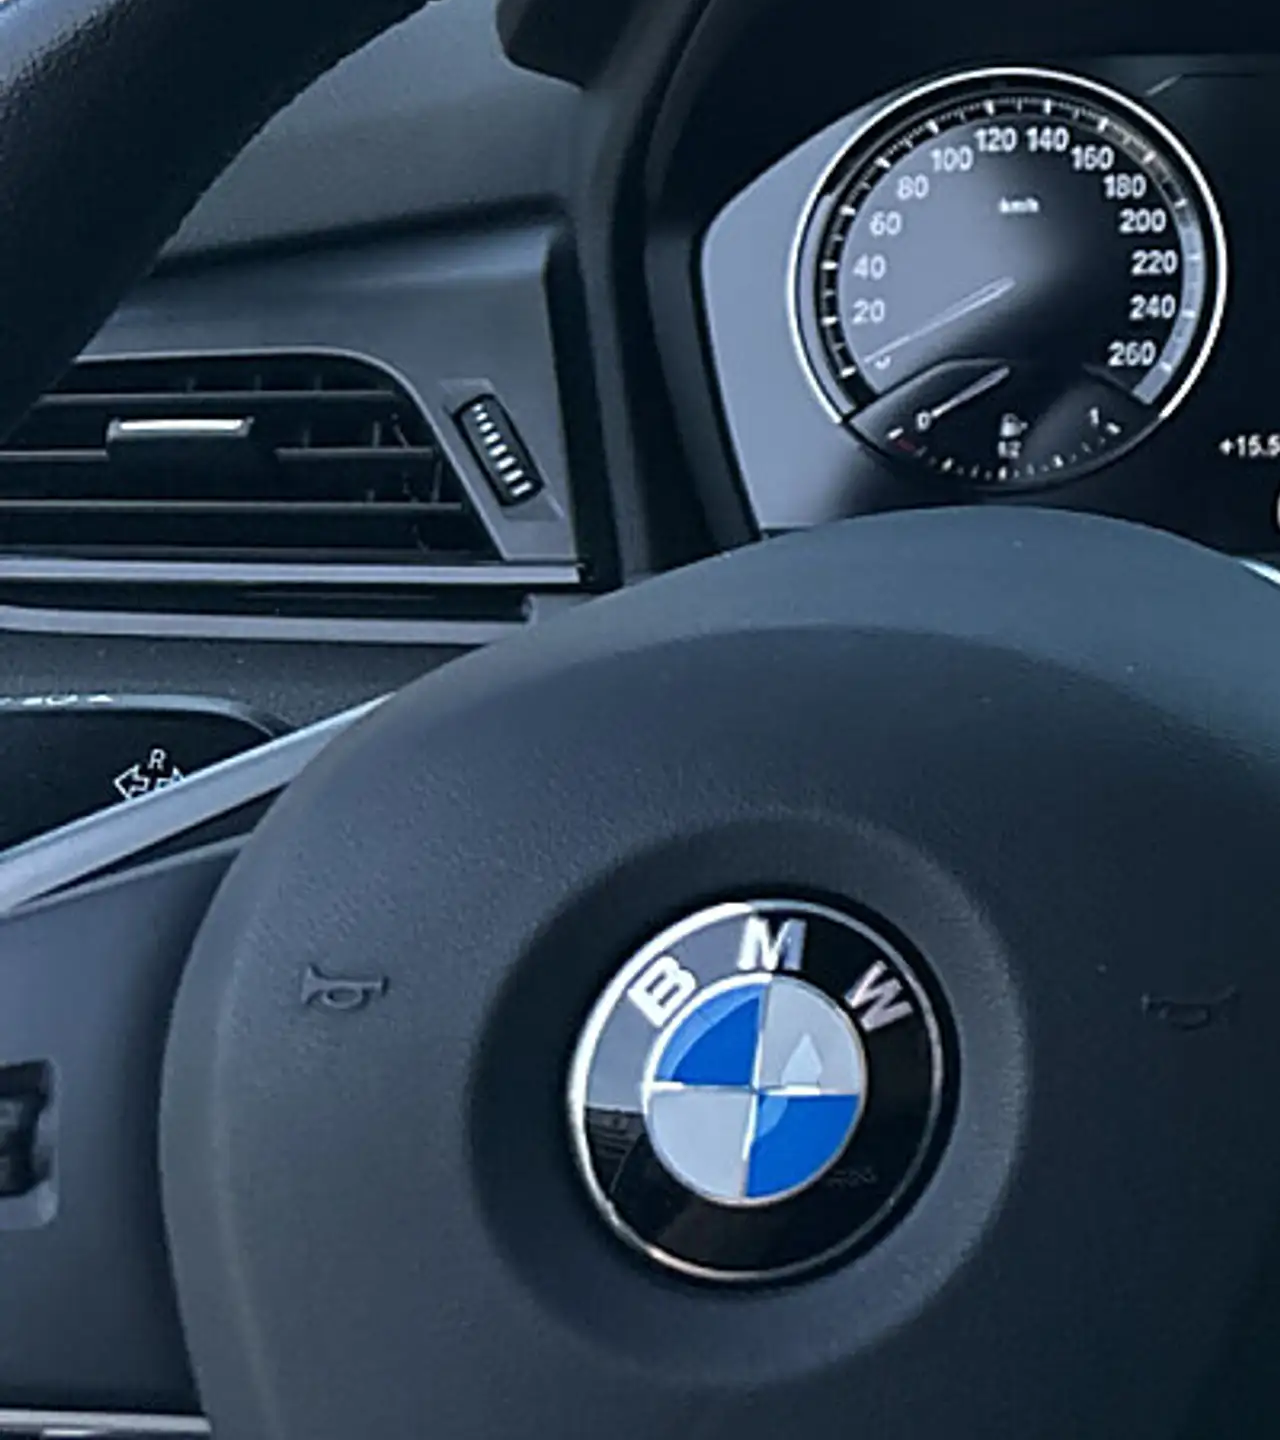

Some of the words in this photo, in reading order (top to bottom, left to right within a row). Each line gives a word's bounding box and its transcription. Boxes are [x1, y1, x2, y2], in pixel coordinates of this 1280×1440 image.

[976, 128, 1017, 152] 120
[1026, 128, 1069, 152] 140
[930, 146, 974, 171] 100
[1071, 146, 1114, 171] 160
[897, 176, 930, 200] 80
[1104, 175, 1146, 199] 180
[869, 212, 901, 236] 60
[1119, 209, 1166, 234] 200
[853, 255, 885, 280] 40
[1132, 251, 1178, 275] 220
[852, 299, 885, 325] 20
[1129, 295, 1176, 320] 240
[1108, 341, 1156, 367] 260
[915, 411, 932, 431] 0
[147, 747, 167, 771] R
[628, 917, 913, 1033] BMW
